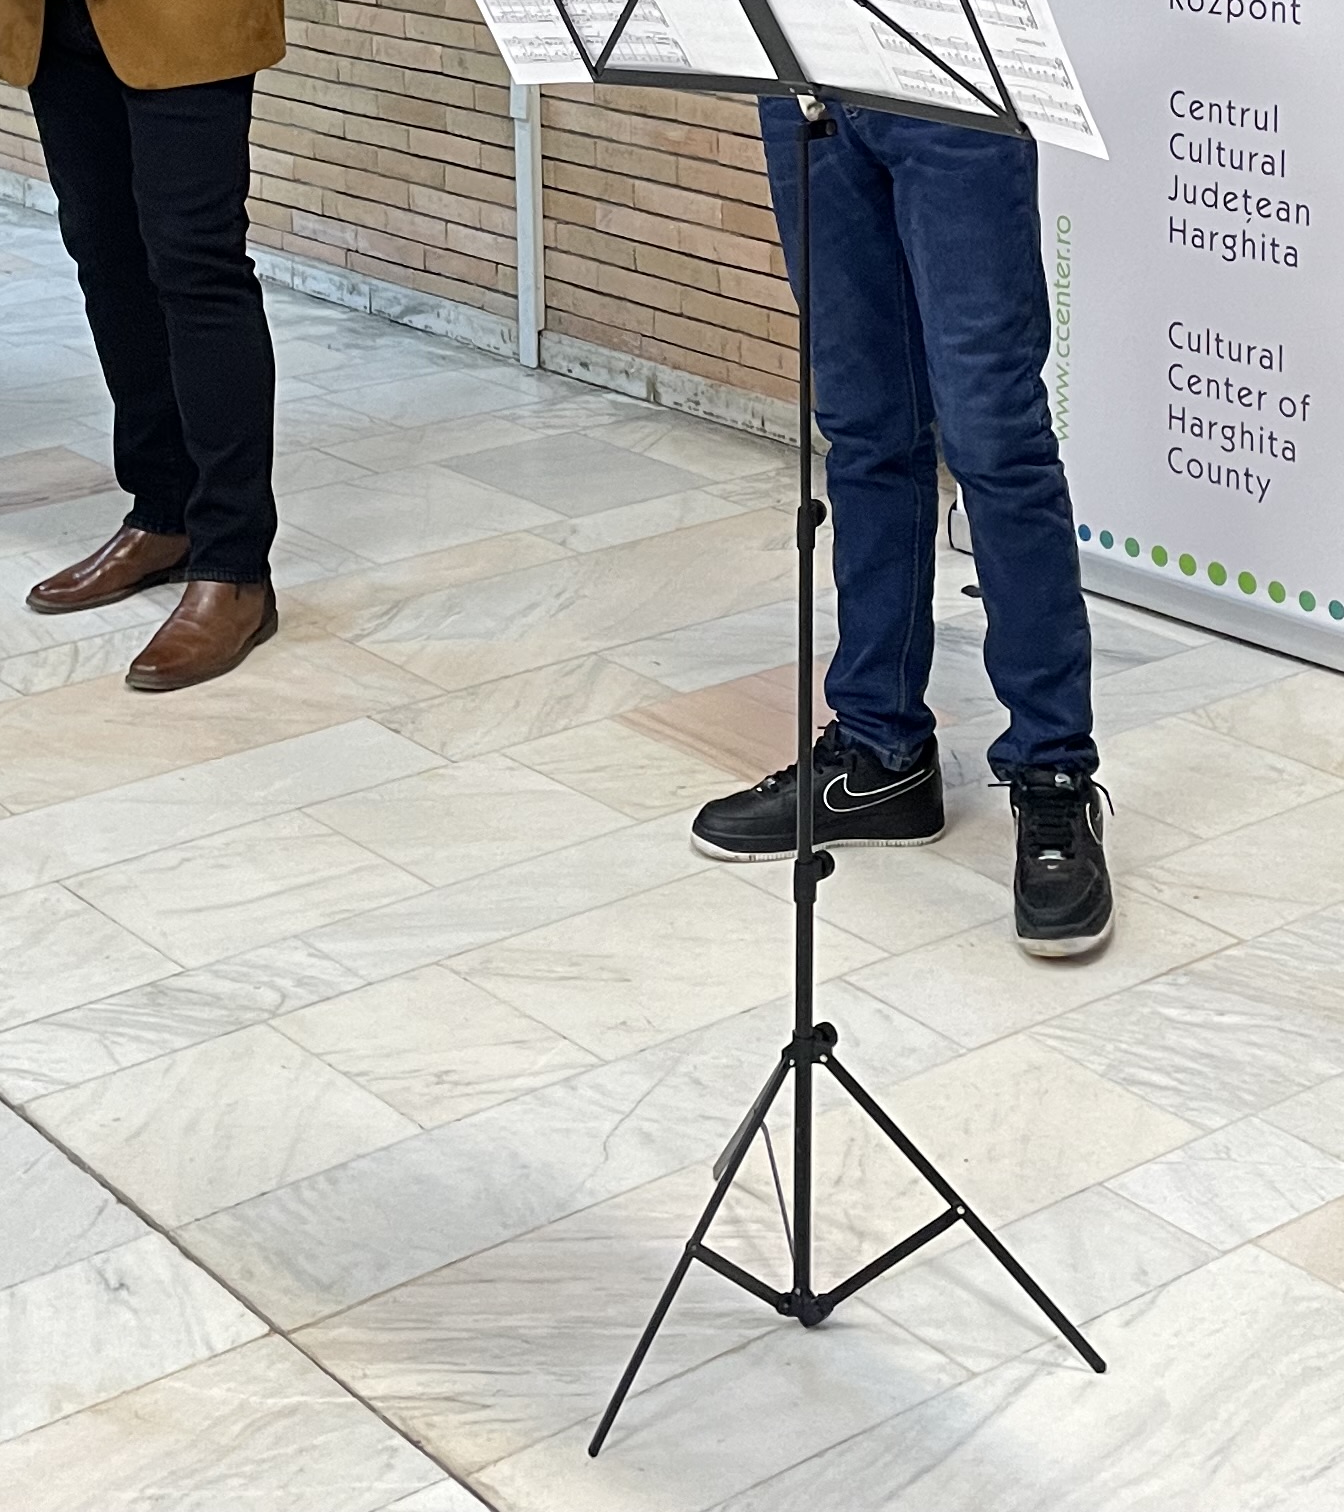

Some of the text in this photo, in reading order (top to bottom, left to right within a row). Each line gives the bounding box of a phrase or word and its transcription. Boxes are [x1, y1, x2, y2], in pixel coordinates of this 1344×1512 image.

[1170, 90, 1277, 133] Centrul
[1170, 133, 1285, 177] Cultural
[1168, 175, 1309, 226] Județean
[1170, 216, 1297, 268] Harghita
[1053, 215, 1072, 441] www.ccenter.ro
[1169, 322, 1282, 372] Cultural
[1169, 364, 1310, 421] Center of
[1169, 404, 1295, 462] Harghita
[1168, 447, 1270, 503] County
